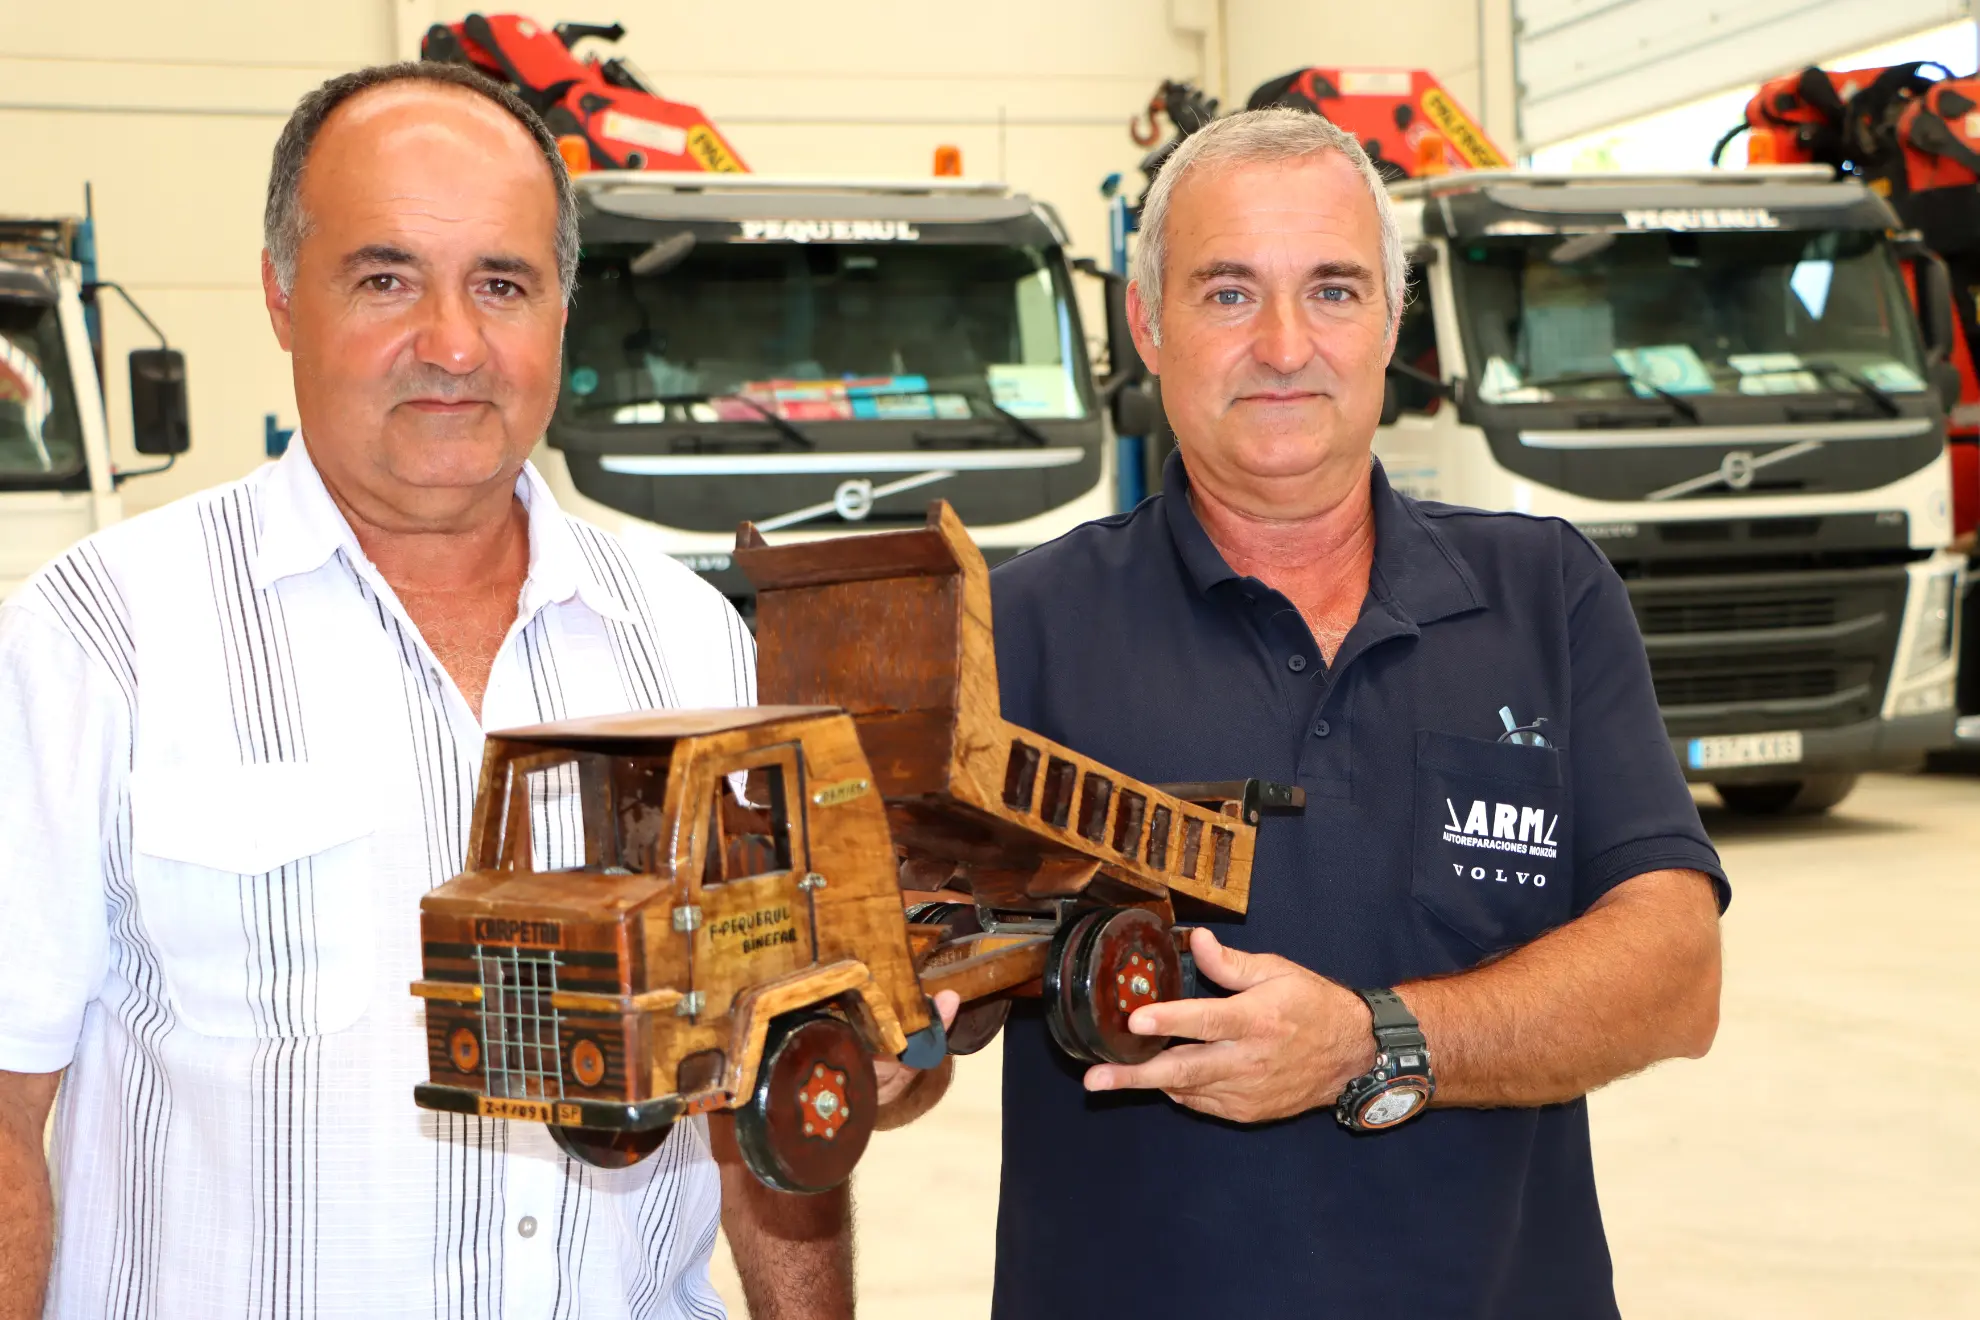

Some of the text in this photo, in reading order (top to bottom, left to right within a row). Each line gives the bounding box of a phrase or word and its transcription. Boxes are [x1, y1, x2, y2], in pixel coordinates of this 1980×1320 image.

[739, 219, 920, 244] PEQUERUL
[1622, 208, 1780, 232] PEQUERUL
[1463, 800, 1545, 844] ARM
[1443, 831, 1557, 859] AUTOREPARACIONES MONZÓN
[1453, 863, 1546, 887] VOLVO
